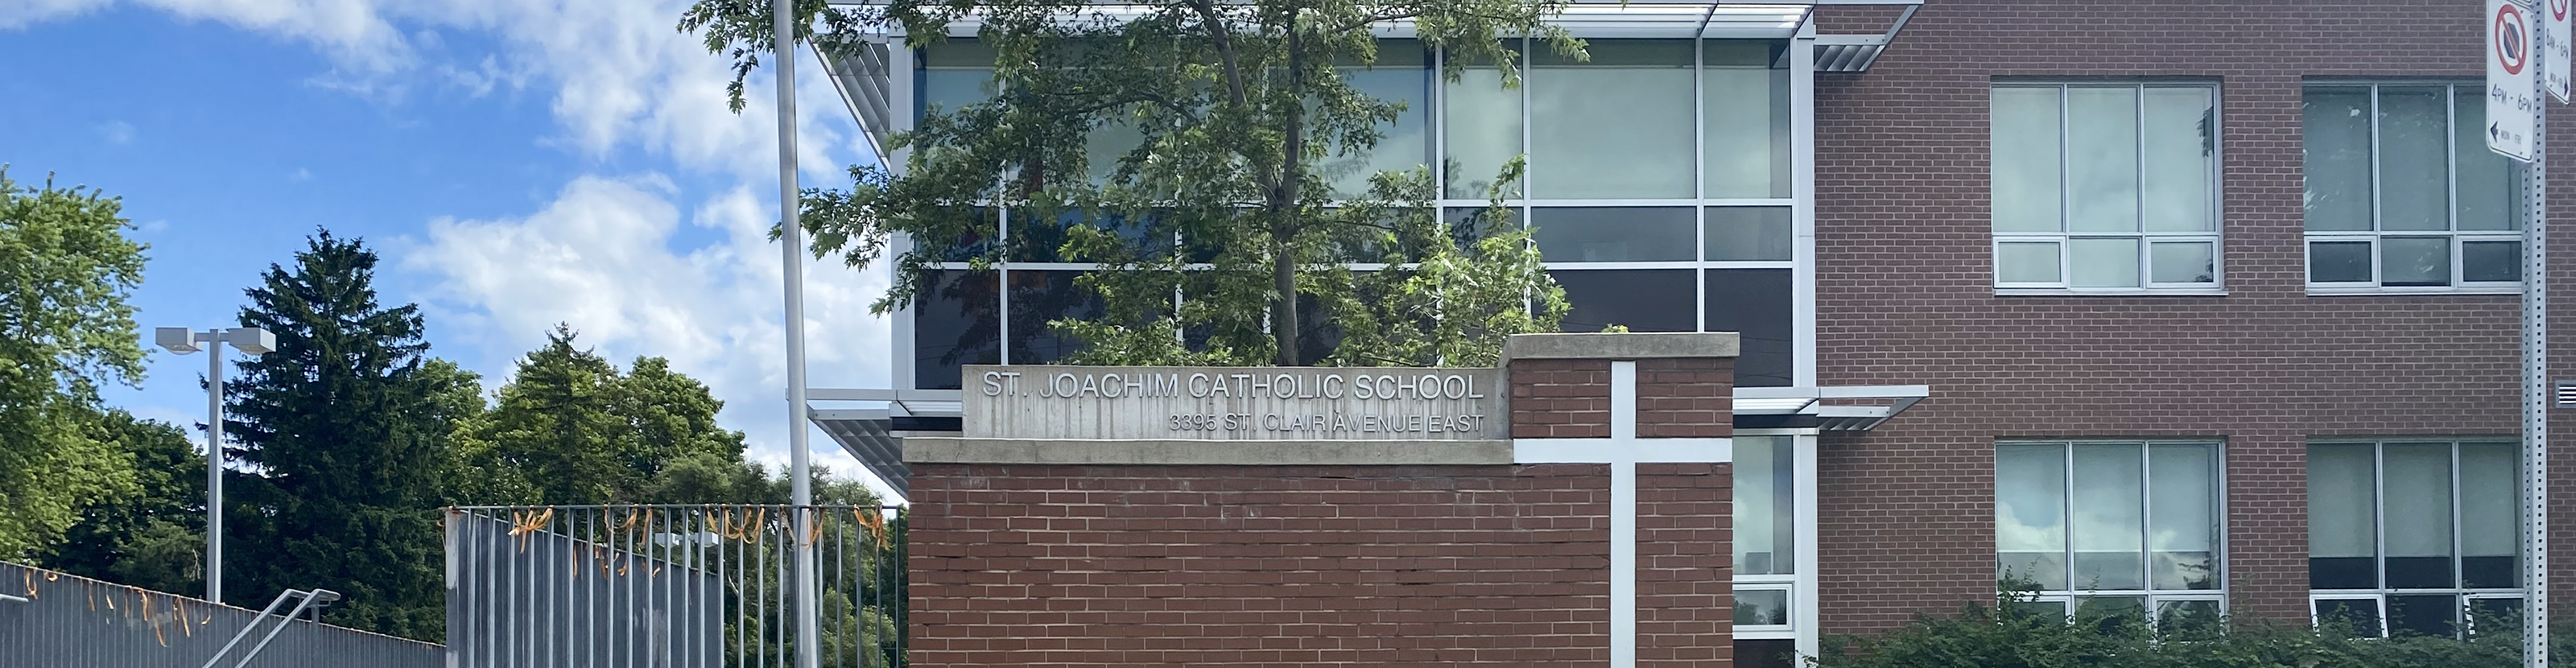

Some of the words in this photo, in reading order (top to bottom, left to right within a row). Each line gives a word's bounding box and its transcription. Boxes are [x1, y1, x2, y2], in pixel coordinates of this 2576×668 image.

[2491, 83, 2507, 105] 4PM
[2518, 93, 2533, 113] 6PM
[982, 370, 1028, 397] ST.
[1039, 373, 1179, 398] JOACHIM
[1187, 373, 1344, 399] CATHOLIC
[1354, 374, 1484, 400] SCHOOL
[1170, 414, 1217, 431] 3395
[1224, 413, 1257, 431] ST.
[1264, 413, 1326, 431] CLAIR
[1332, 414, 1421, 432] AVENUE
[1428, 414, 1484, 433] EAST
